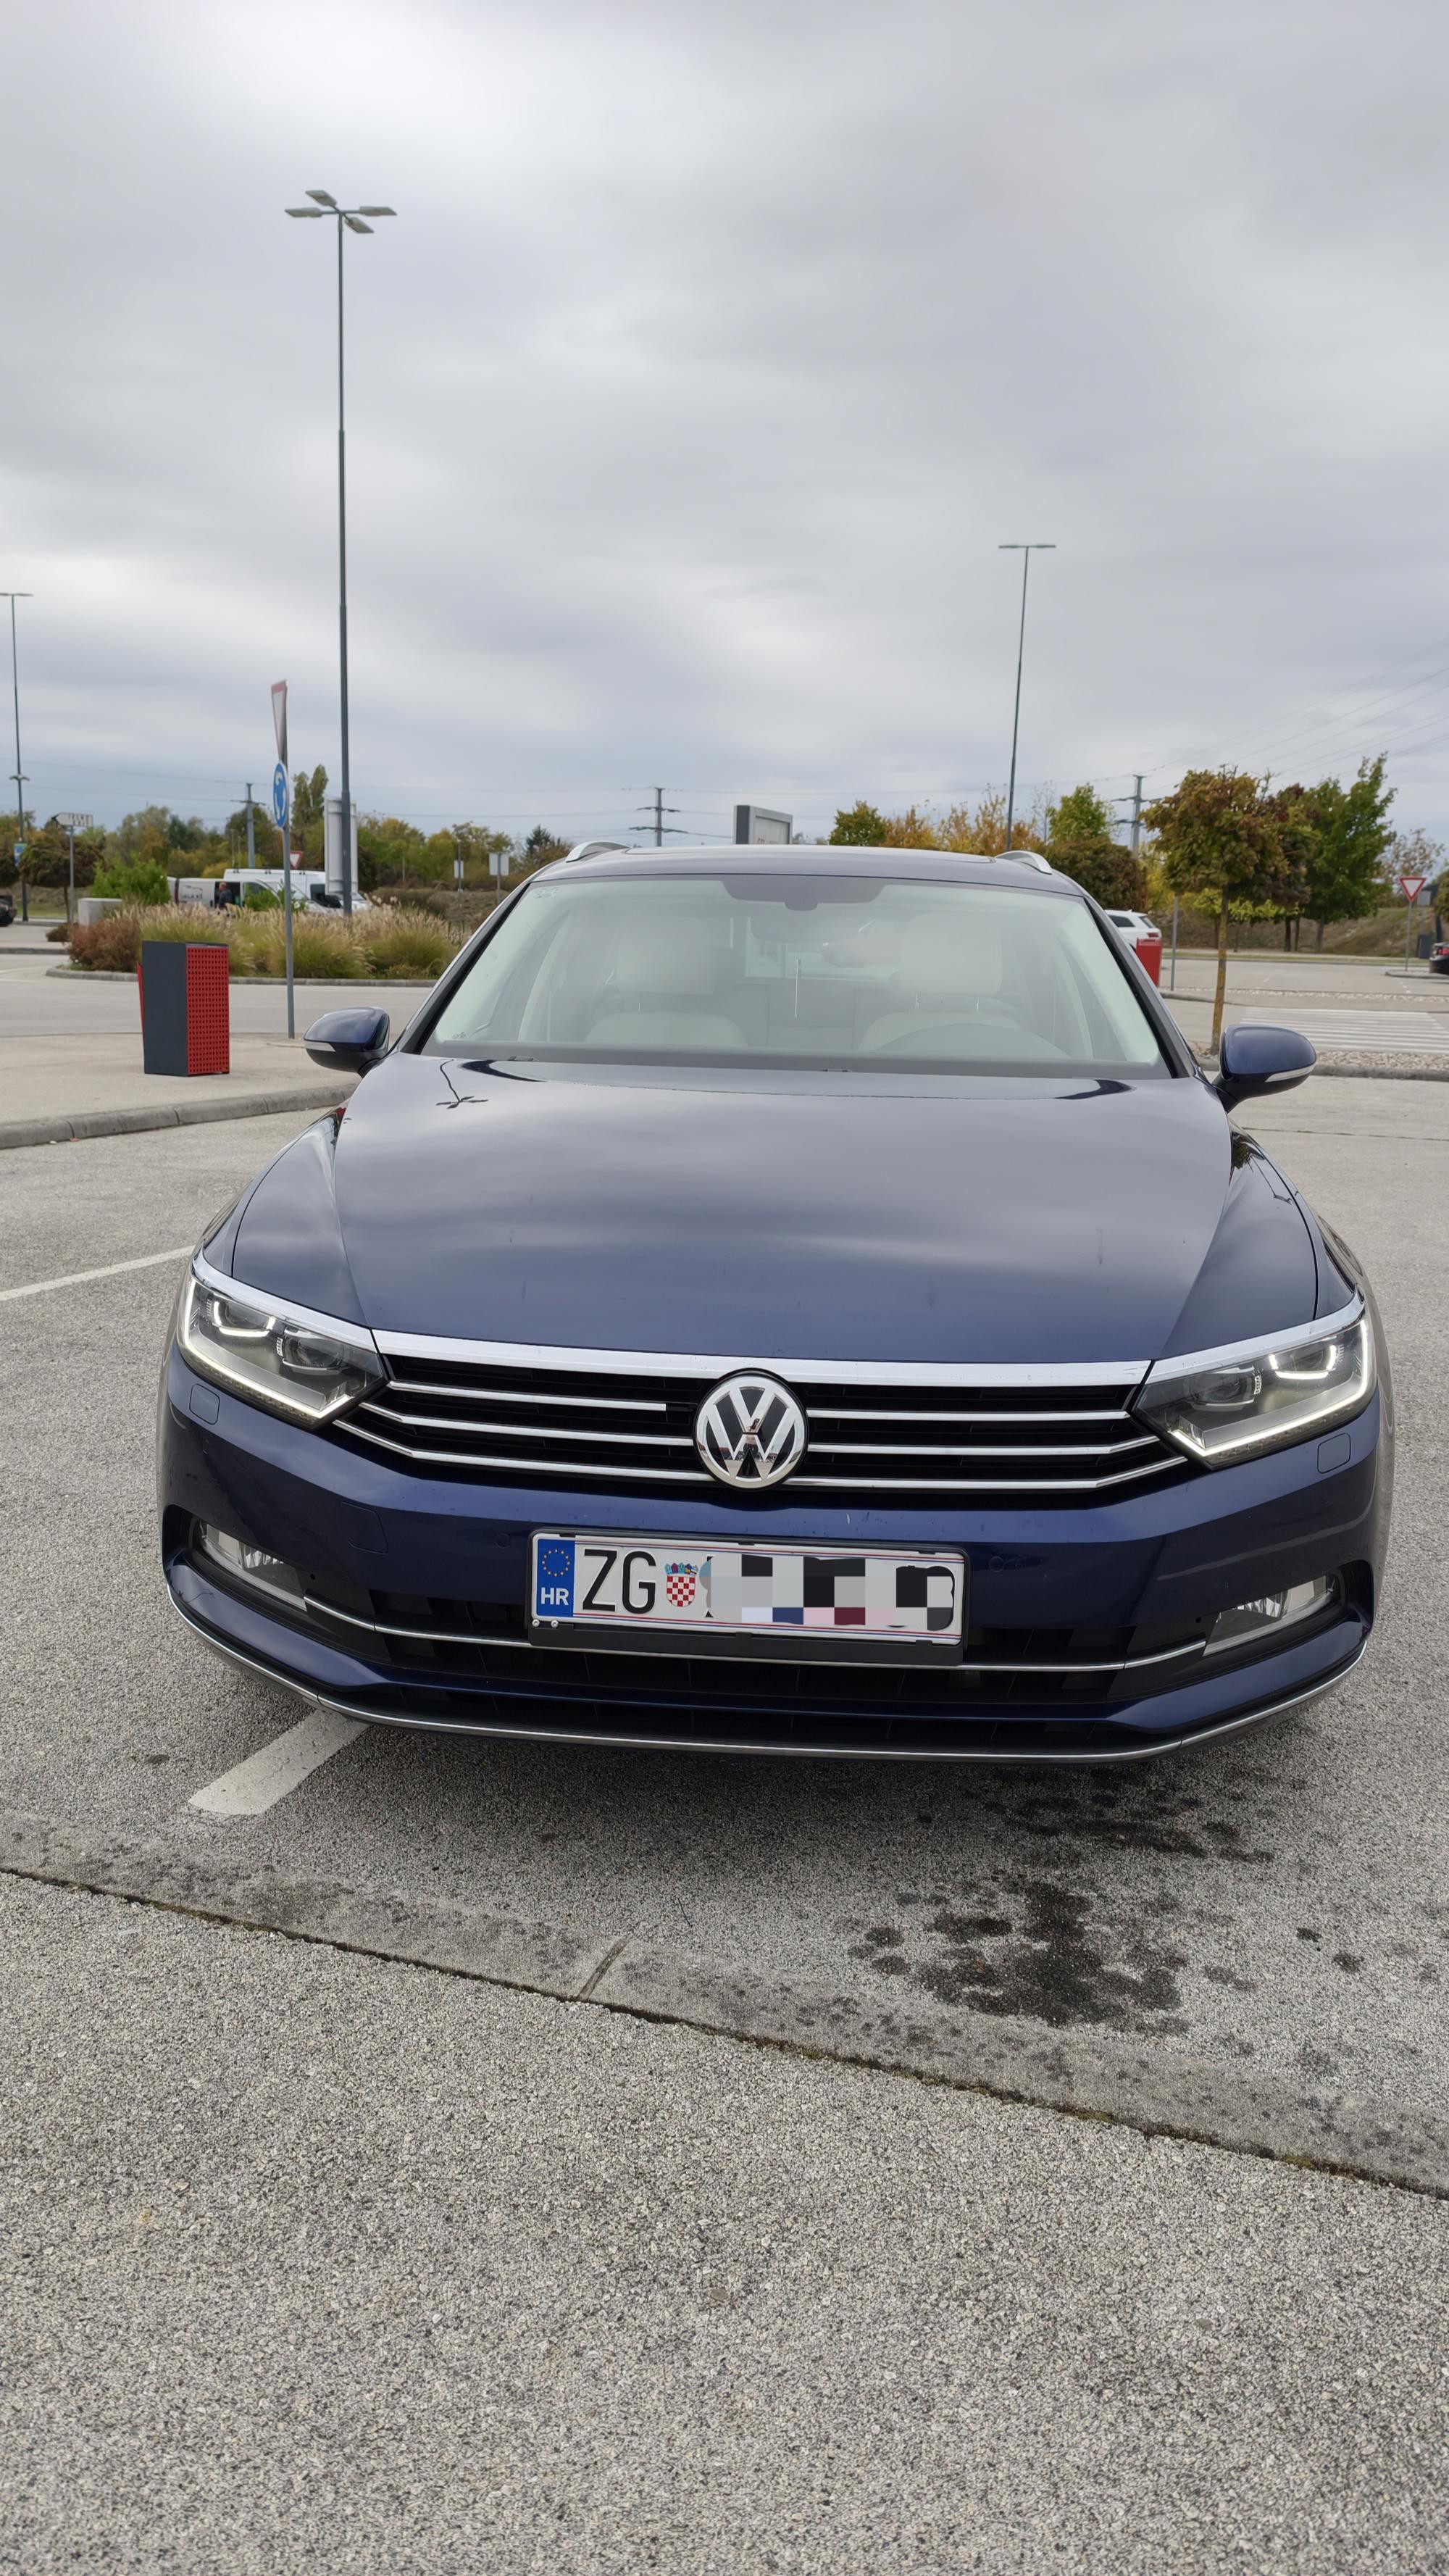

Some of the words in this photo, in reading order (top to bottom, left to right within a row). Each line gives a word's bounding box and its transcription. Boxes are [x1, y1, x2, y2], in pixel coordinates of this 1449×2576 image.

[701, 1383, 799, 1483] VW
[540, 1587, 569, 1606] HR
[582, 1548, 656, 1614] ZG
